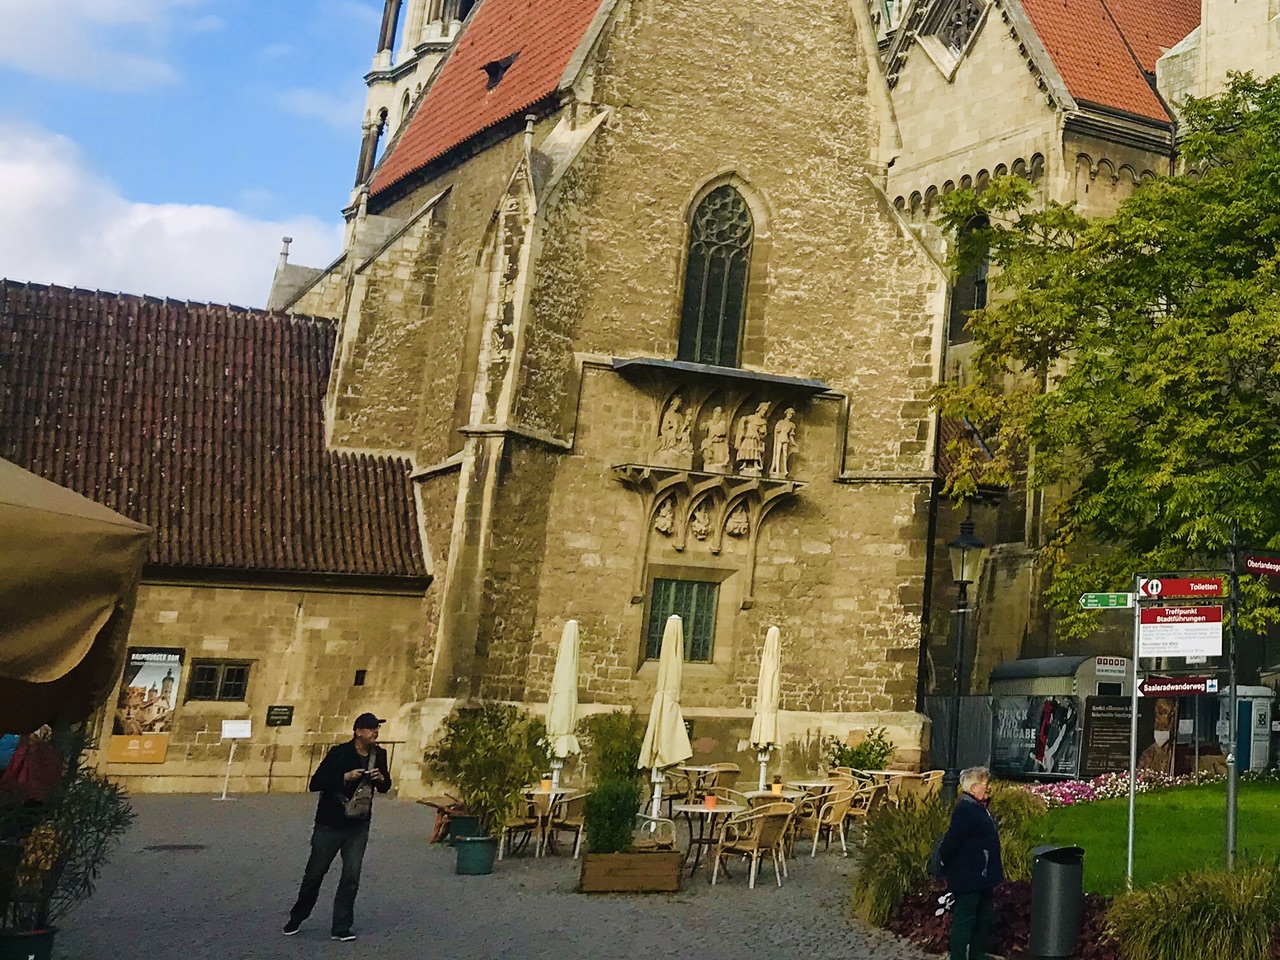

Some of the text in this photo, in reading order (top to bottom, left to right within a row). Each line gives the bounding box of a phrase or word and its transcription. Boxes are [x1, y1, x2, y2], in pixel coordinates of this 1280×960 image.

[1190, 583, 1218, 591] Toiletten
[1165, 608, 1197, 616] Treffpunkt
[1156, 614, 1206, 623] Stadtführungen
[1144, 682, 1206, 692] Saaleradwanderweg
[998, 708, 1028, 720] DRUCK
[999, 718, 1018, 728] UND
